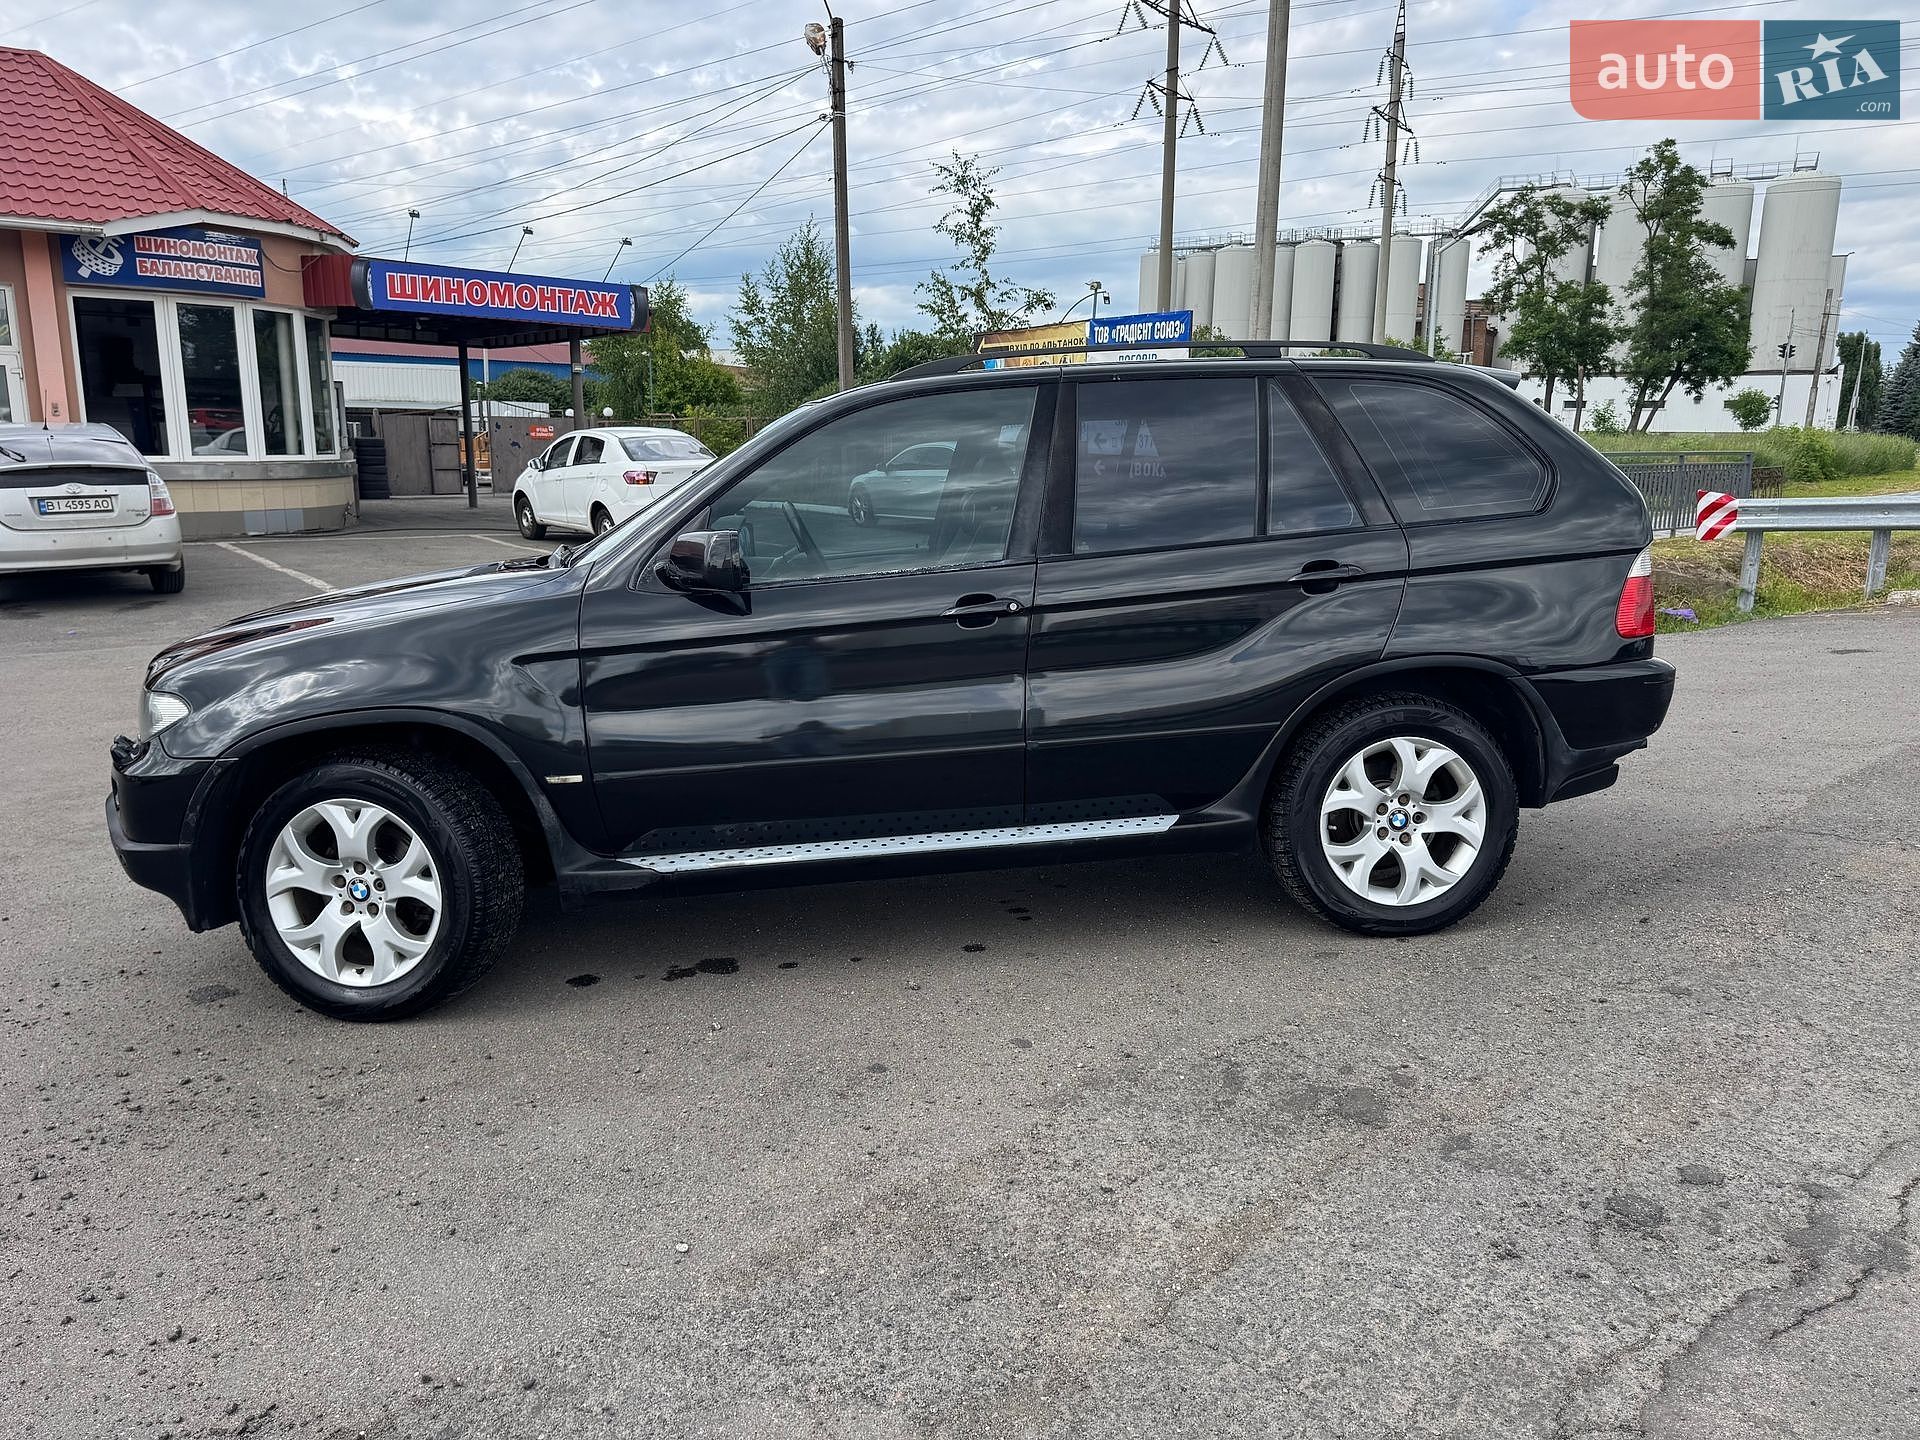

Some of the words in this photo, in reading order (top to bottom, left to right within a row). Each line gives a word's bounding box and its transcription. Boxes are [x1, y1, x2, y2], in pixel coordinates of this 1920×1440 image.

[134, 235, 260, 266] ШИНОМОНТАЖ
[136, 257, 262, 288] БАЛАНСУВАННЯ
[386, 272, 620, 318] ШИНОМОНТАЖ
[1094, 326, 1109, 344] ТОВ
[1111, 322, 1152, 344] «ГРАДІЄНТ
[1154, 319, 1185, 340] СОЮЗ»
[46, 501, 60, 511] BI
[65, 500, 91, 510] 4595
[94, 499, 110, 509] AO
